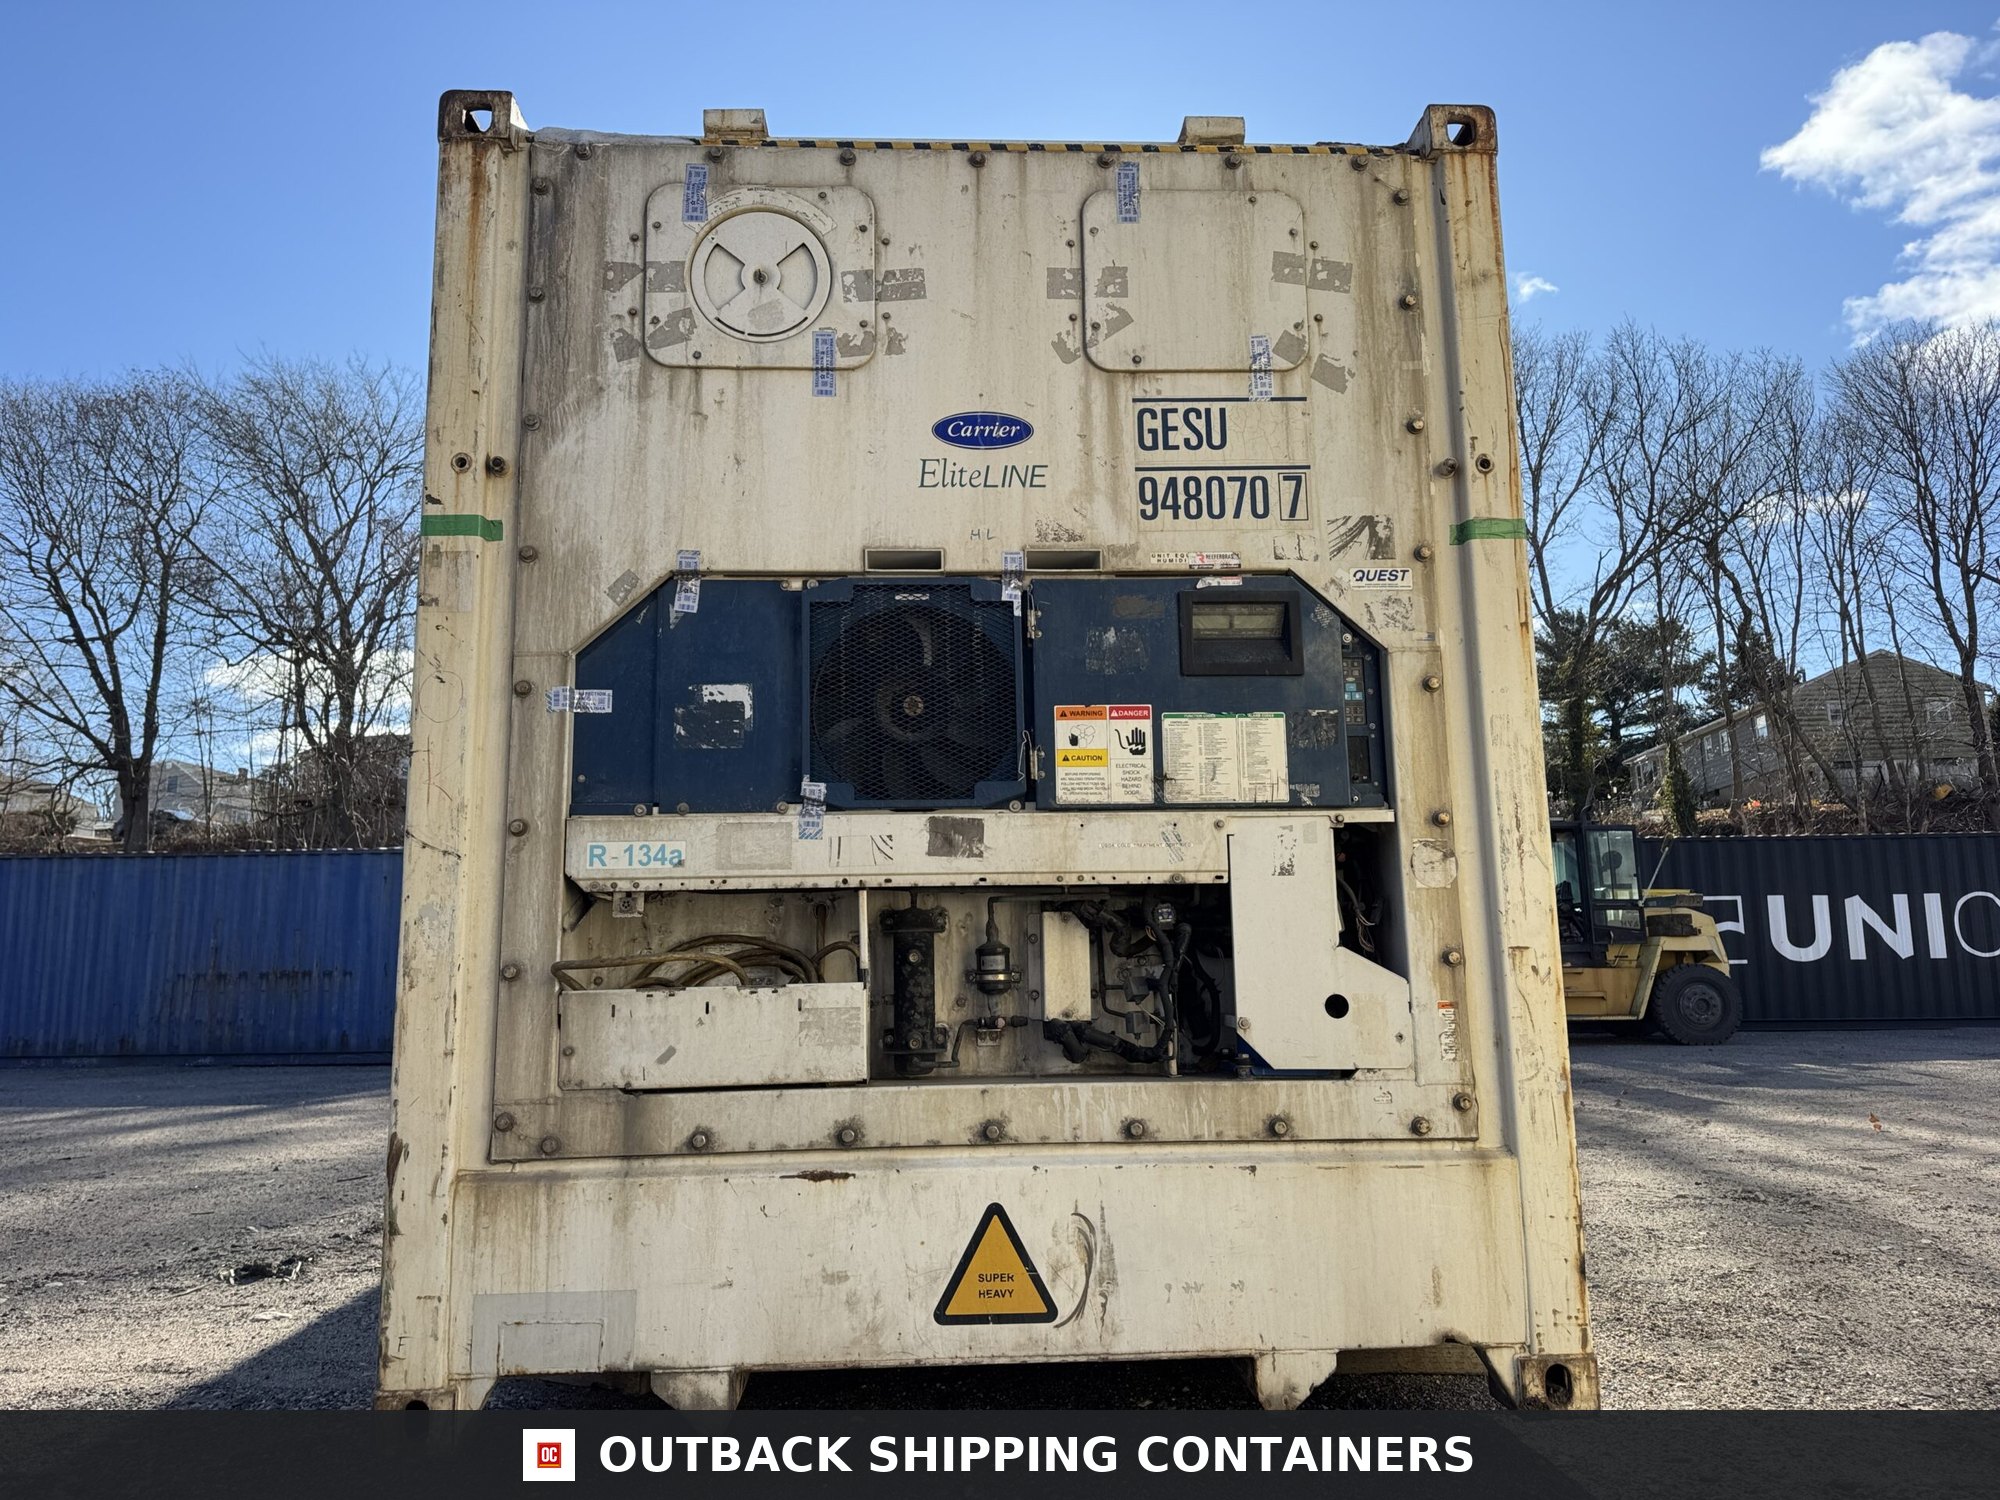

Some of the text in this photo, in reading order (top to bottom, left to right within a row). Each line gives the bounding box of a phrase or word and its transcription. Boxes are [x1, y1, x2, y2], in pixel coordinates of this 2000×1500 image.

[947, 420, 1020, 440] Carrier
[1137, 407, 1227, 451] GESU
[918, 458, 1048, 489] EliteLINE
[1139, 474, 1303, 521] 948070 7
[1353, 569, 1409, 582] QUEST
[978, 1273, 1014, 1283] SUPER
[978, 1289, 1014, 1299] HEAVY
